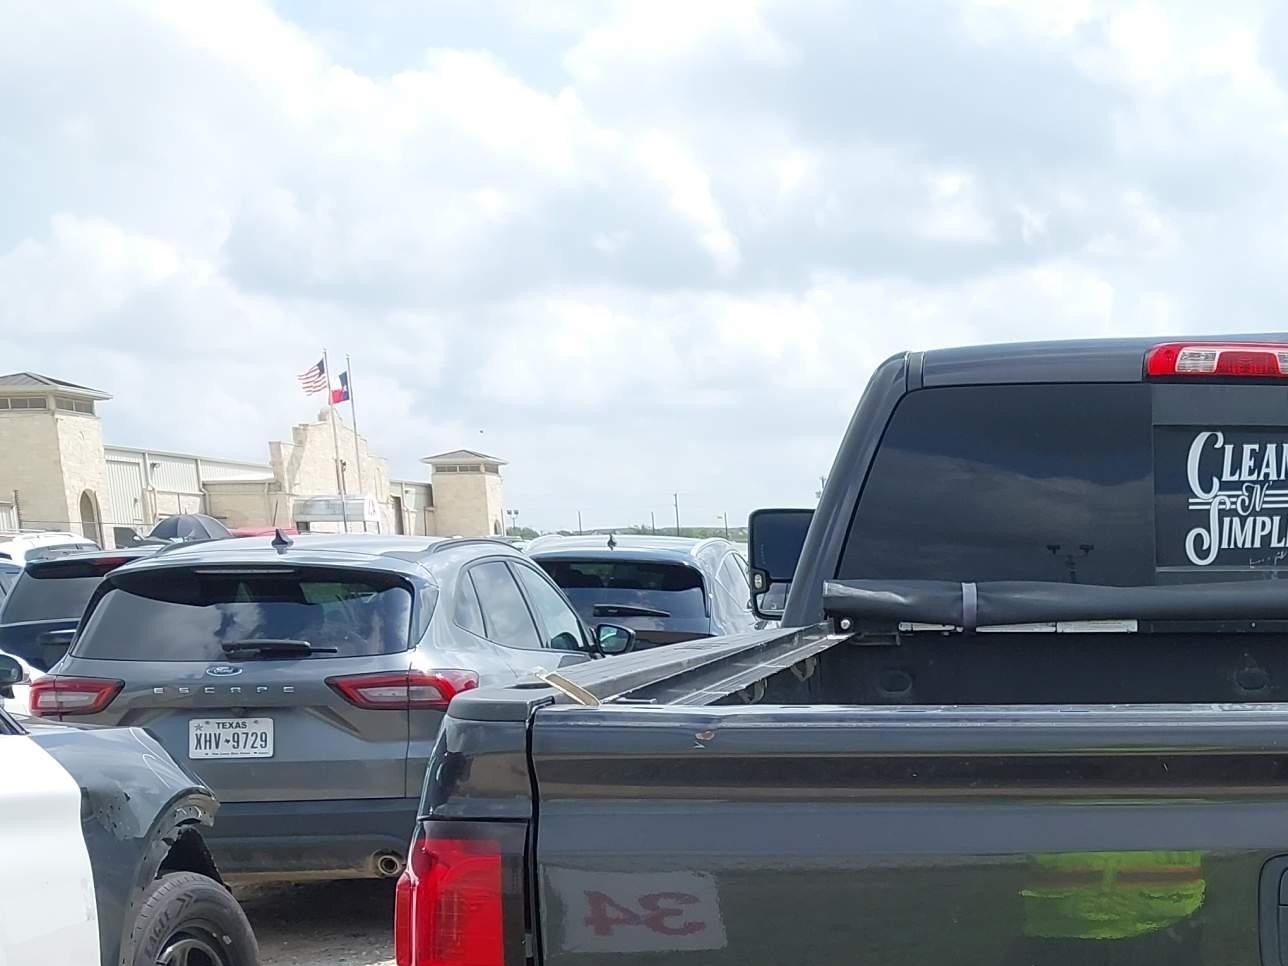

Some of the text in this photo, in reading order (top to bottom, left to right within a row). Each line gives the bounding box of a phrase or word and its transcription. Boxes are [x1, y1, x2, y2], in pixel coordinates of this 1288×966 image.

[153, 686, 295, 695] ESCAPE
[215, 721, 247, 730] TEXAS
[194, 731, 268, 750] XHV 9729
